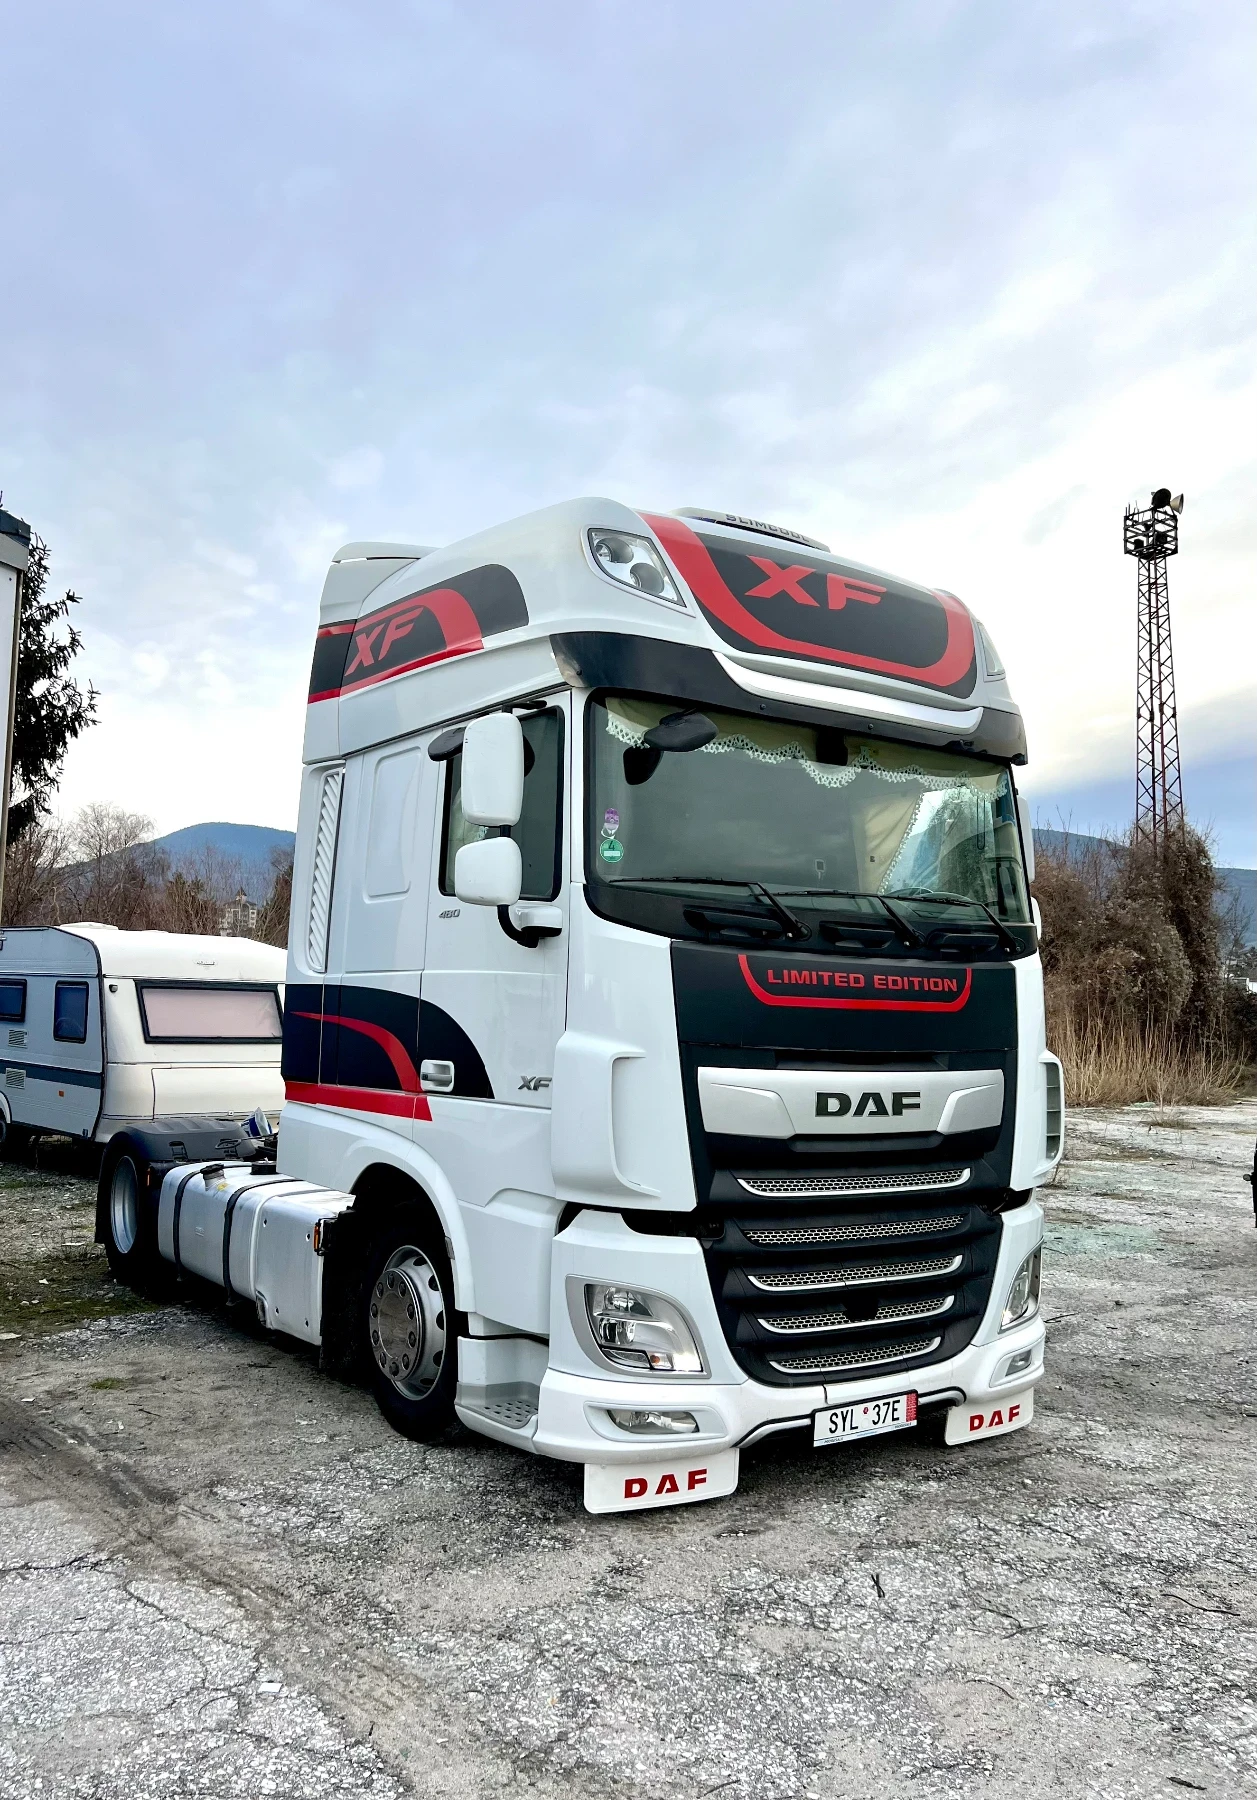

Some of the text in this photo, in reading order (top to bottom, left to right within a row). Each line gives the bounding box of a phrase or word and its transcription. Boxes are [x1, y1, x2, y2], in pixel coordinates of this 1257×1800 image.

[744, 554, 887, 610] XF
[344, 607, 424, 677] XF
[767, 969, 958, 992] LIMITED EDITION
[517, 1075, 552, 1091] XF
[815, 1091, 921, 1117] DAF
[828, 1408, 859, 1434] SYL
[871, 1399, 901, 1426] 37E
[968, 1404, 1021, 1432] DAF
[624, 1468, 708, 1499] DAF
